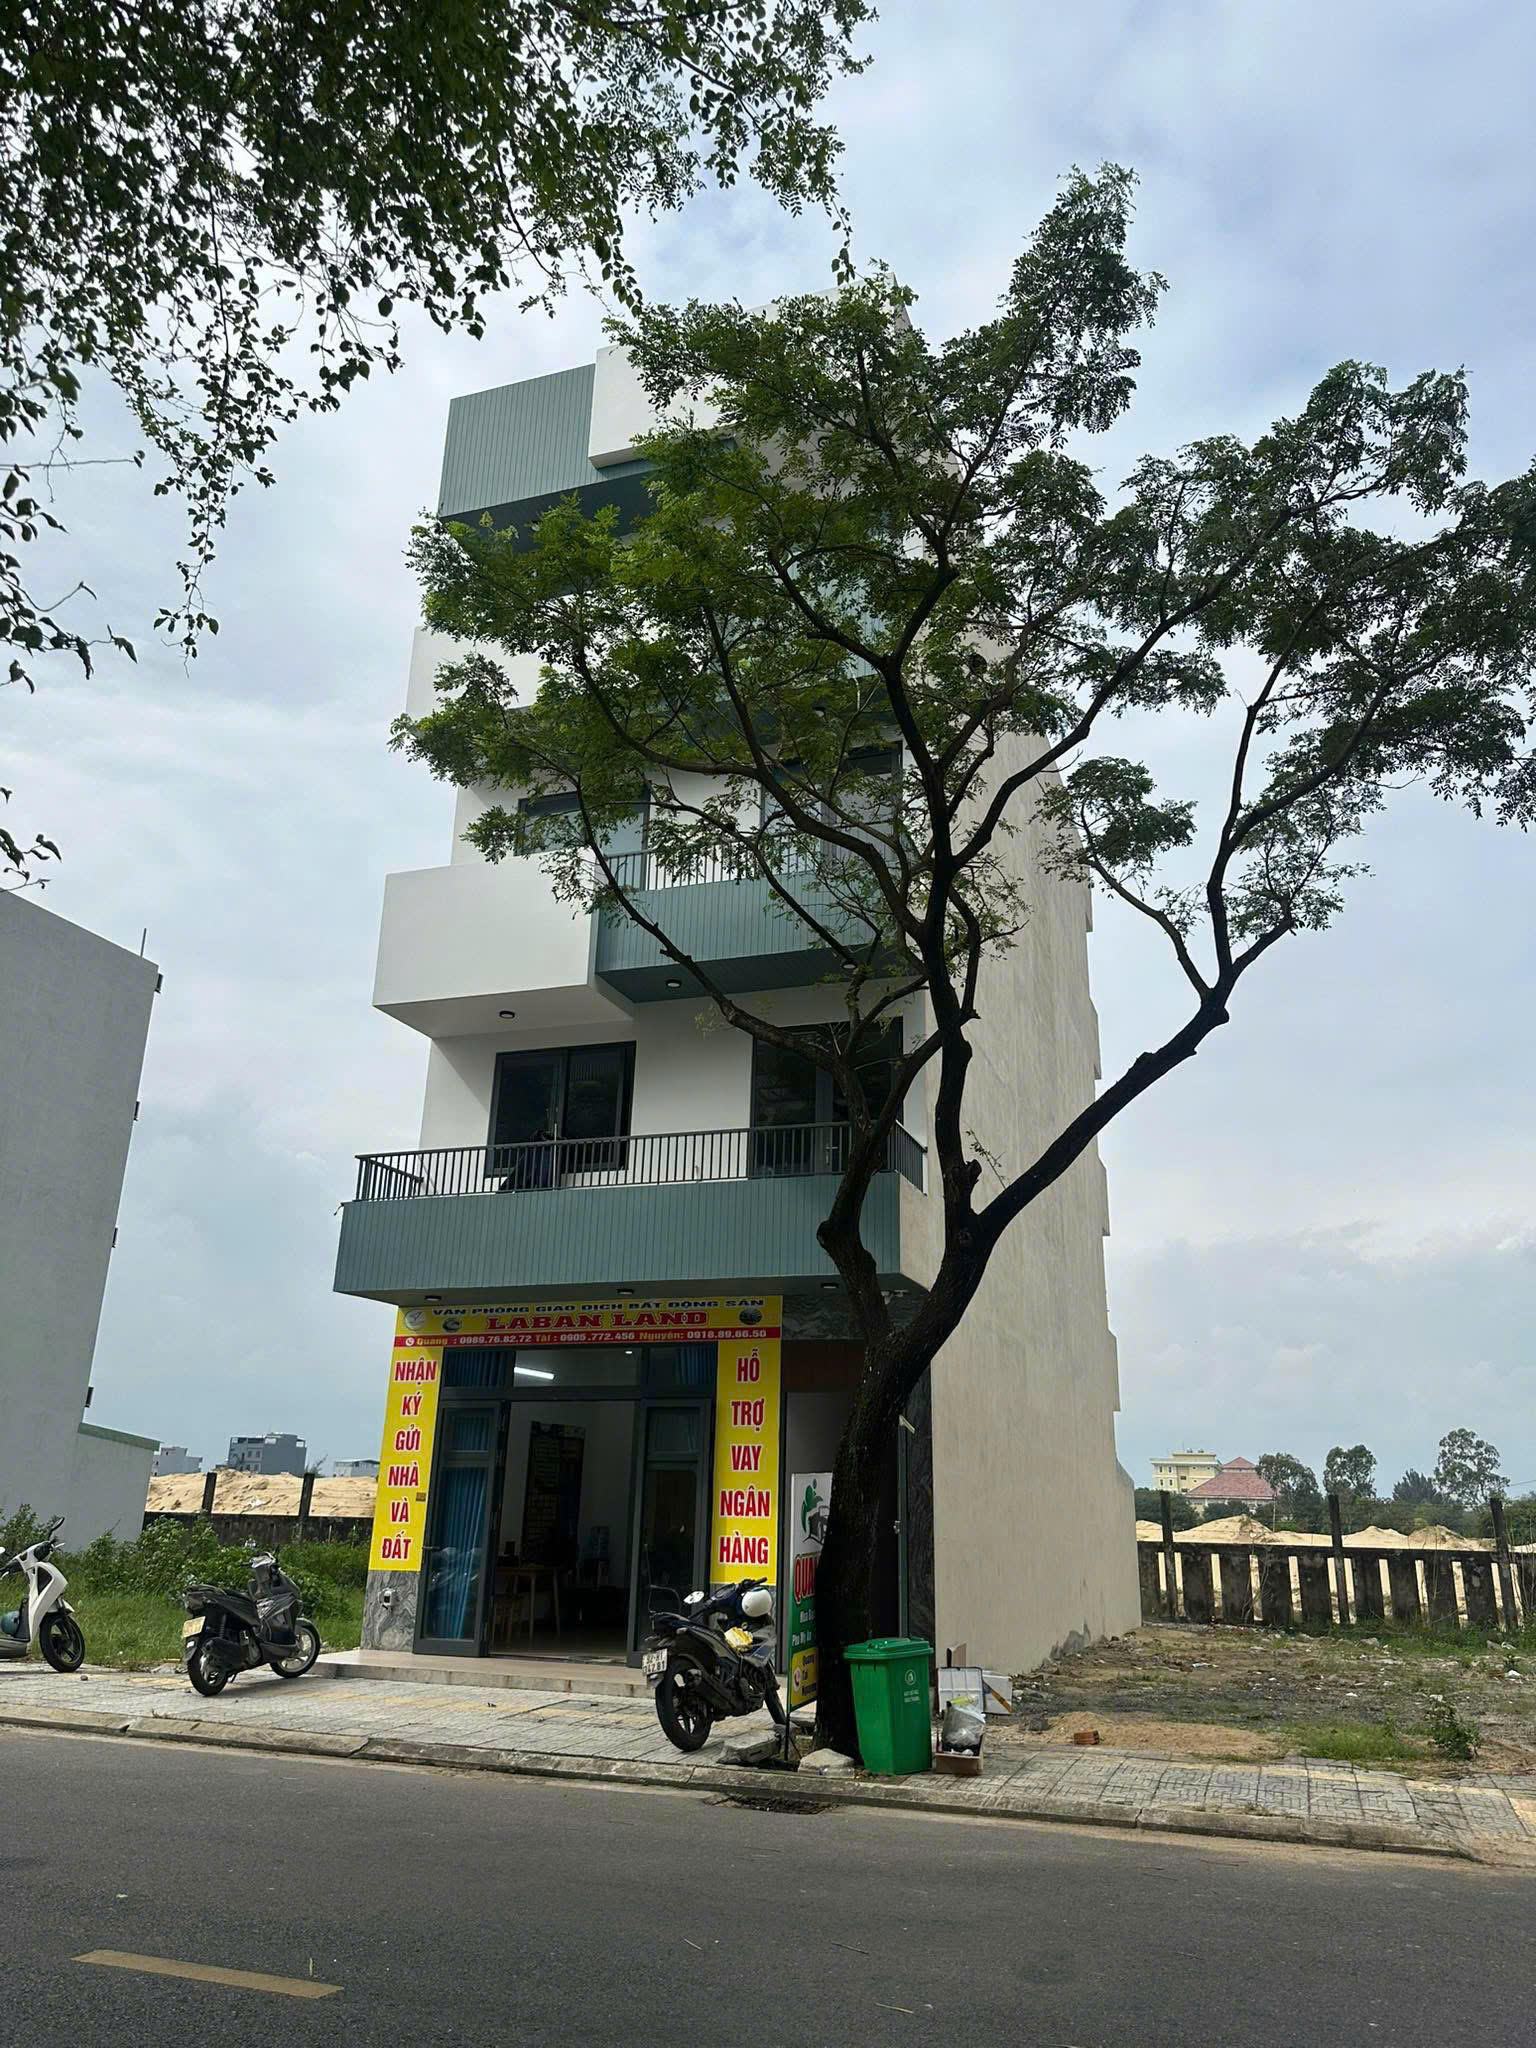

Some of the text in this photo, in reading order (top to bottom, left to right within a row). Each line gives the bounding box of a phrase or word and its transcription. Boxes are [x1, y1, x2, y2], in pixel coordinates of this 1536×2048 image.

[486, 1311, 709, 1330] LABAN LAND
[535, 1303, 575, 1313] GIAO
[394, 1356, 437, 1385] NHẬN
[737, 1348, 760, 1382] HỖ
[402, 1391, 422, 1415] KÝ
[731, 1398, 765, 1432] TRỢ
[395, 1423, 421, 1451] GỬI
[731, 1445, 762, 1471] VAY
[388, 1461, 419, 1487] NHÀ
[391, 1497, 409, 1523] VÀ
[720, 1485, 770, 1517] NGÂN
[381, 1530, 412, 1560] ĐẤT
[719, 1530, 769, 1564] HÀNG
